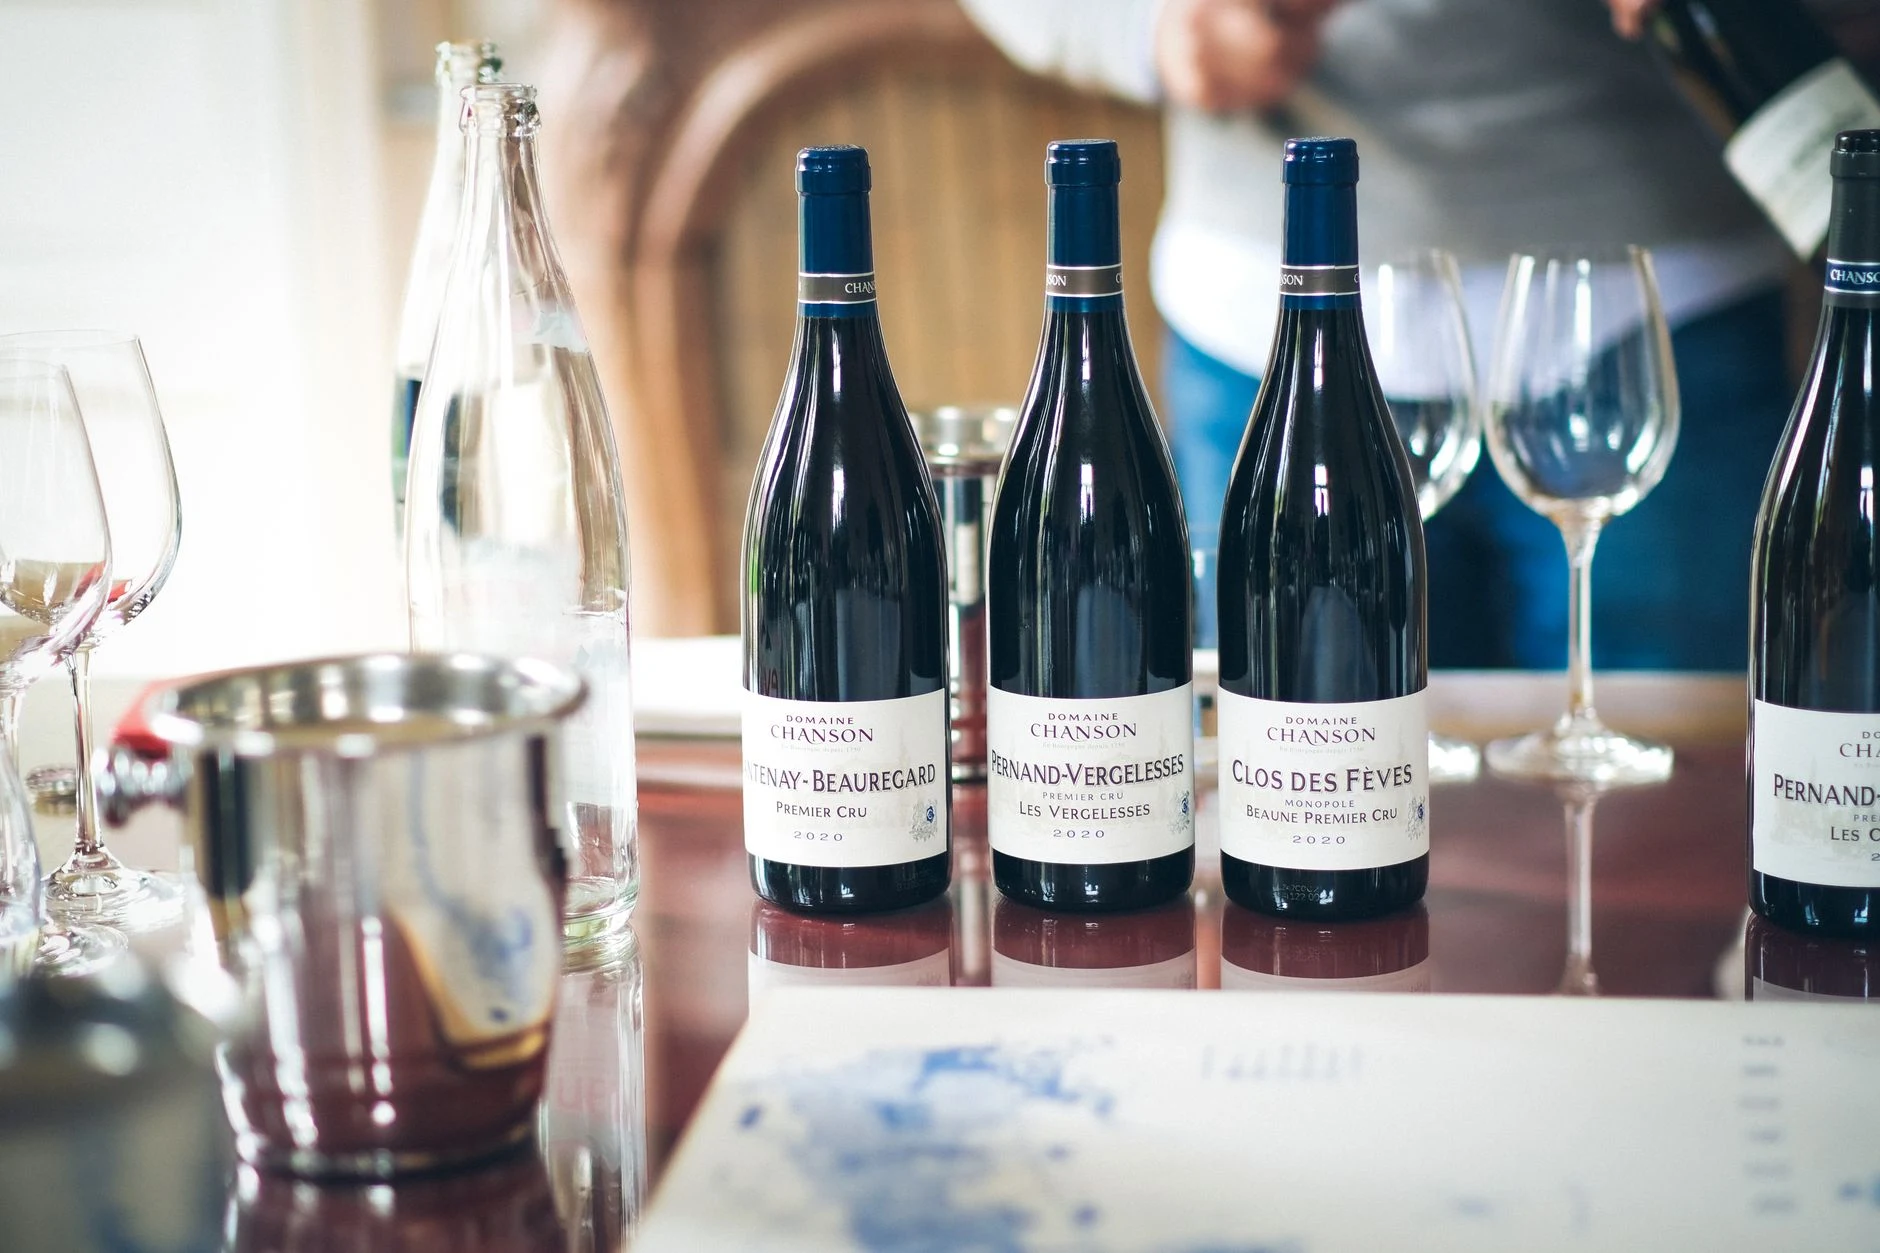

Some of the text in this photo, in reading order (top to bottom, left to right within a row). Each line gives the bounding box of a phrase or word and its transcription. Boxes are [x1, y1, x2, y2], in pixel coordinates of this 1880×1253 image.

[786, 715, 854, 725] DOMAINE
[1048, 712, 1119, 721] DOMAINE
[1285, 716, 1357, 725] DOMAINE
[771, 725, 873, 744] CHANSON
[1030, 723, 1137, 742] CHANSON
[1267, 727, 1375, 746] CHANSON
[991, 749, 1184, 786] PERNAND-VERGELESSES
[1232, 759, 1413, 793] CLOS DES FÈVES
[1043, 792, 1124, 801] PREMIER CRU
[776, 801, 867, 818] PREMIER CRU
[1285, 799, 1355, 808] MONOPOLE
[1019, 801, 1150, 820] LES VERGELESSES
[1246, 804, 1398, 825] BEAUNE PREMIER CRU
[1854, 814, 1880, 822] PRE
[793, 830, 843, 841] 2020
[1053, 829, 1105, 839] 2020
[1293, 835, 1345, 845] 2020
[1831, 826, 1860, 842] LES
